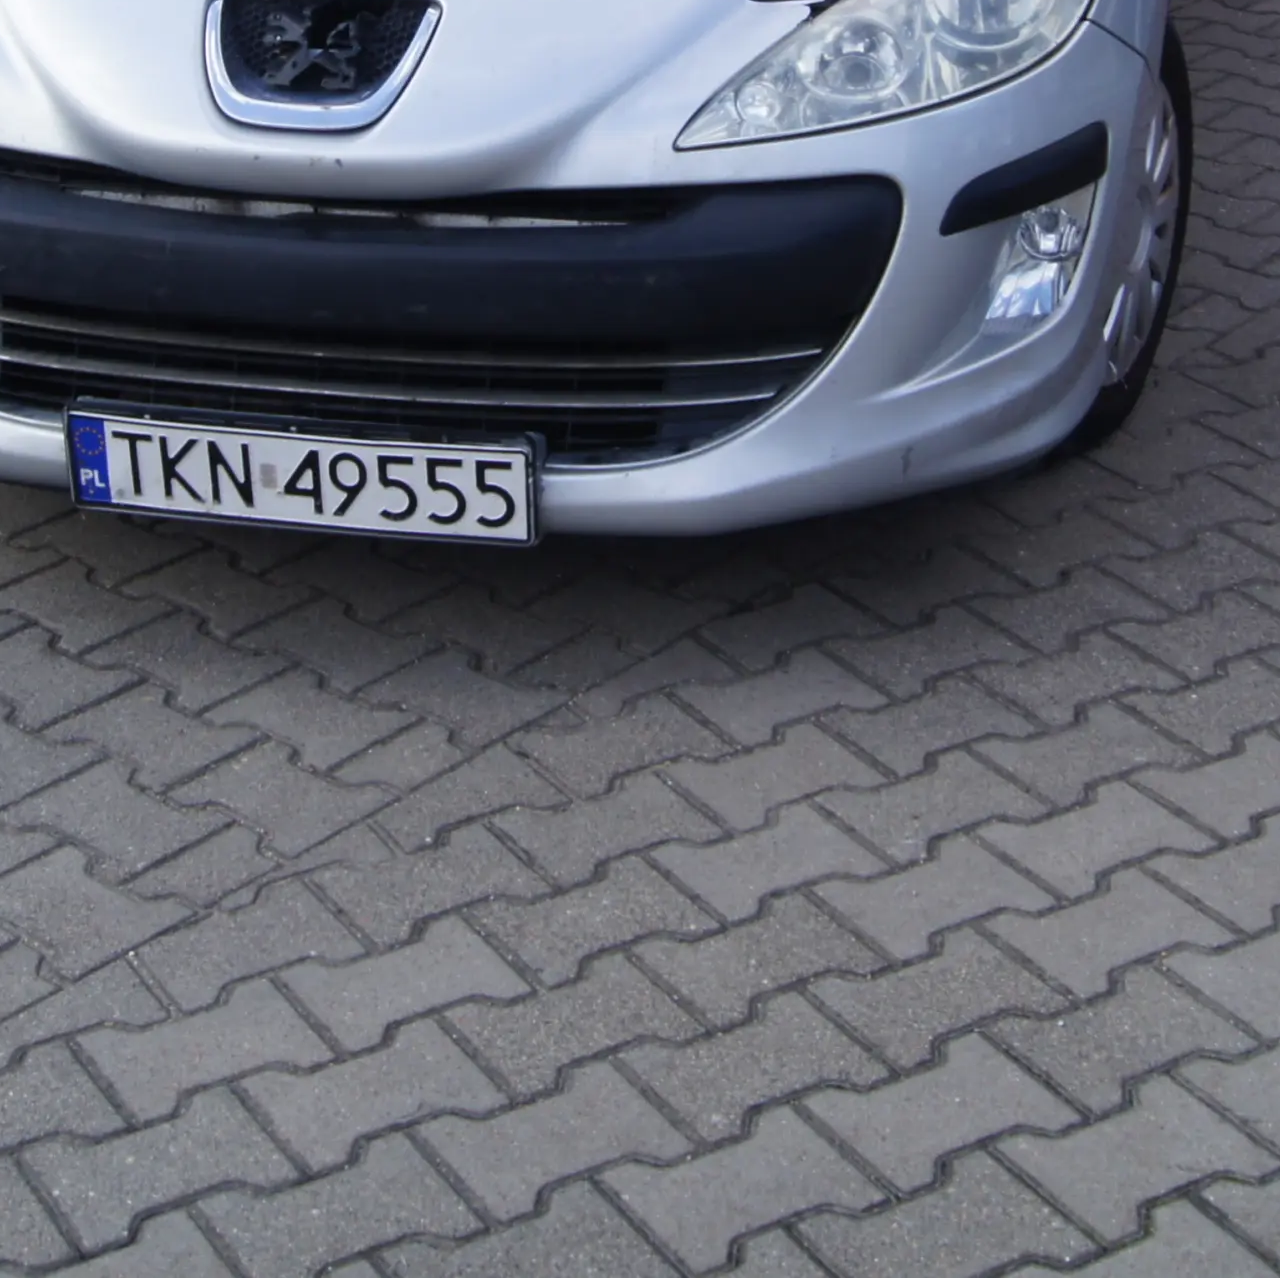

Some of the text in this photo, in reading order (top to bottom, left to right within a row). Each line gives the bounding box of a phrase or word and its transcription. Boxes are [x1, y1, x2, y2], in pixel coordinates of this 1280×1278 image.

[80, 468, 106, 487] PL
[111, 431, 517, 528] TKN 49555
